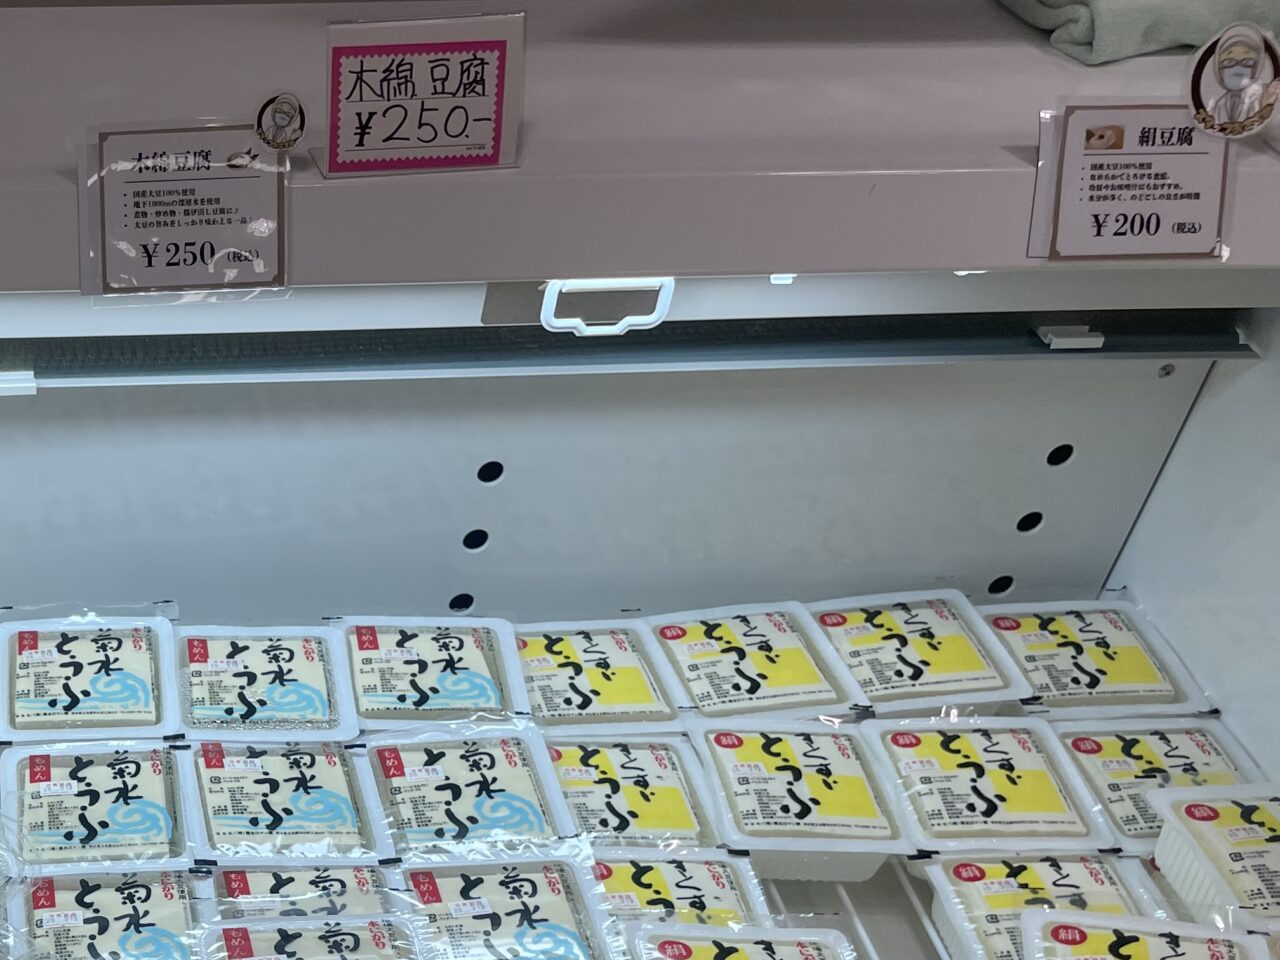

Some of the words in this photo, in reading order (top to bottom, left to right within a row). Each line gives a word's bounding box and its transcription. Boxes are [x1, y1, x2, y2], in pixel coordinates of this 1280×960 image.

[345, 53, 490, 102] 木綿豆腐
[1138, 126, 1196, 147] 絹豆腐
[132, 149, 212, 173] 木綿豆腐
